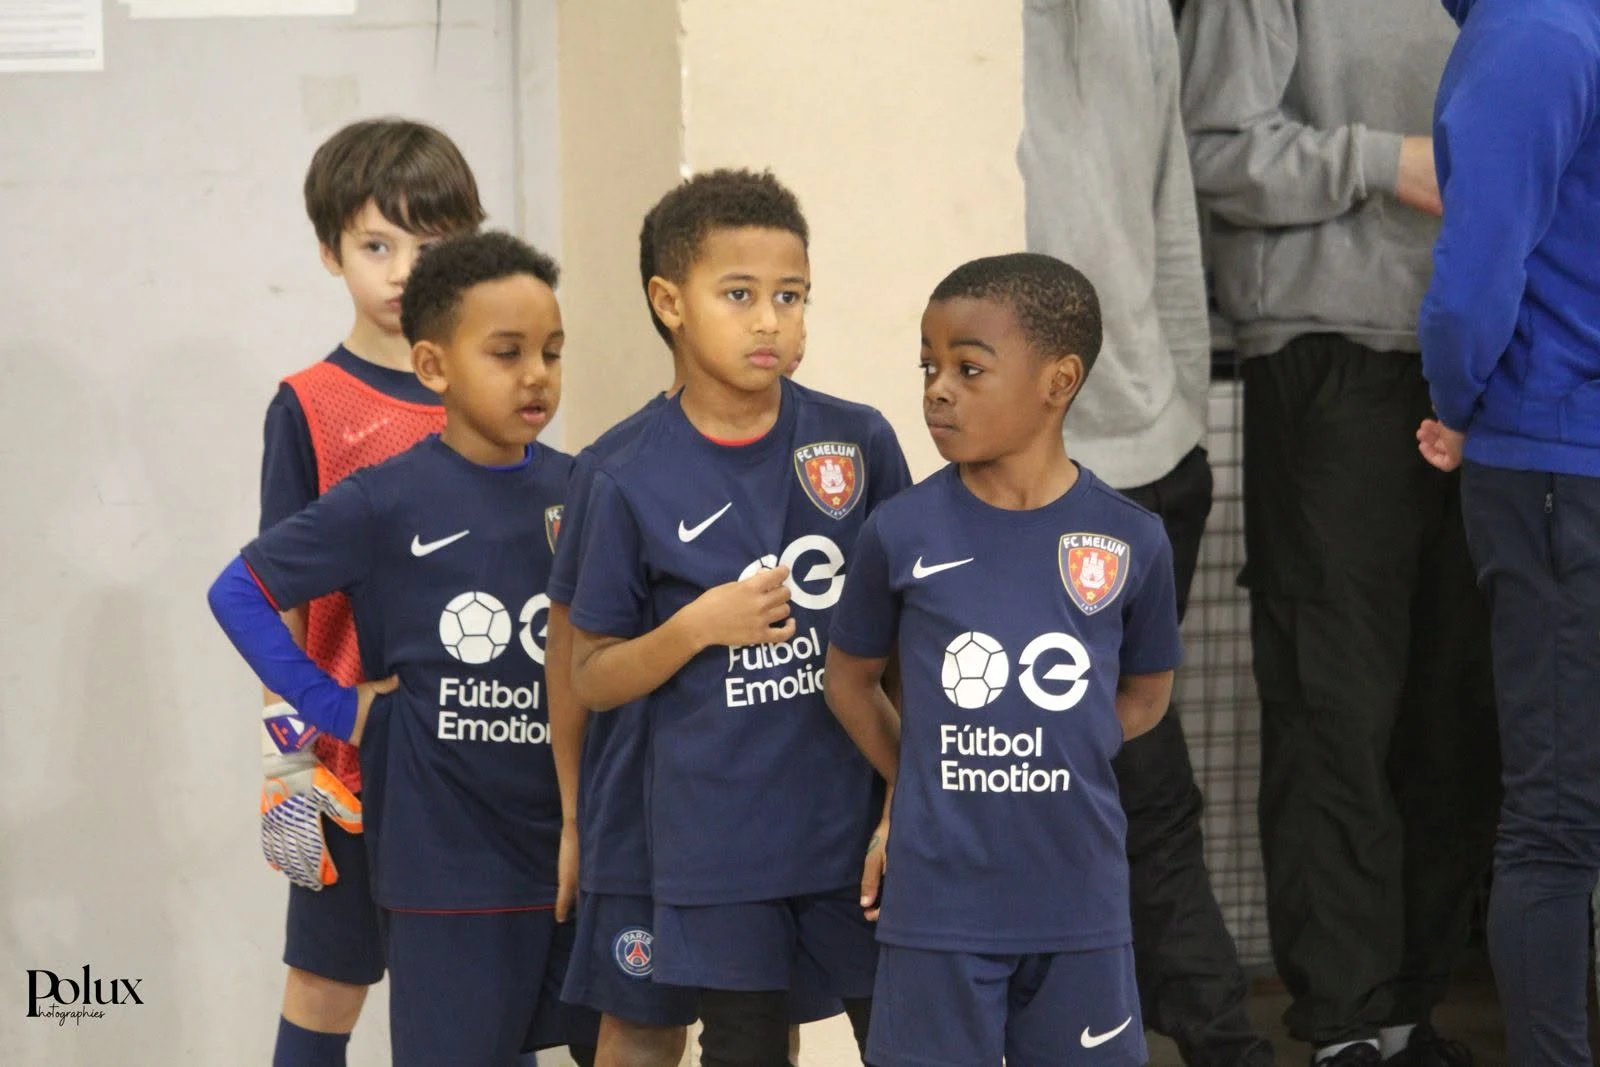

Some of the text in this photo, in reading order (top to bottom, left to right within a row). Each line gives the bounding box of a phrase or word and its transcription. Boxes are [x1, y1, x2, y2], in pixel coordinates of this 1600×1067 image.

[797, 444, 855, 462] FC MELUN
[1063, 535, 1126, 557] FC MELUN
[439, 677, 539, 709] Fútbol
[940, 724, 1043, 757] Fútbol
[940, 760, 1070, 793] Emotion
[623, 932, 653, 945] PARIS
